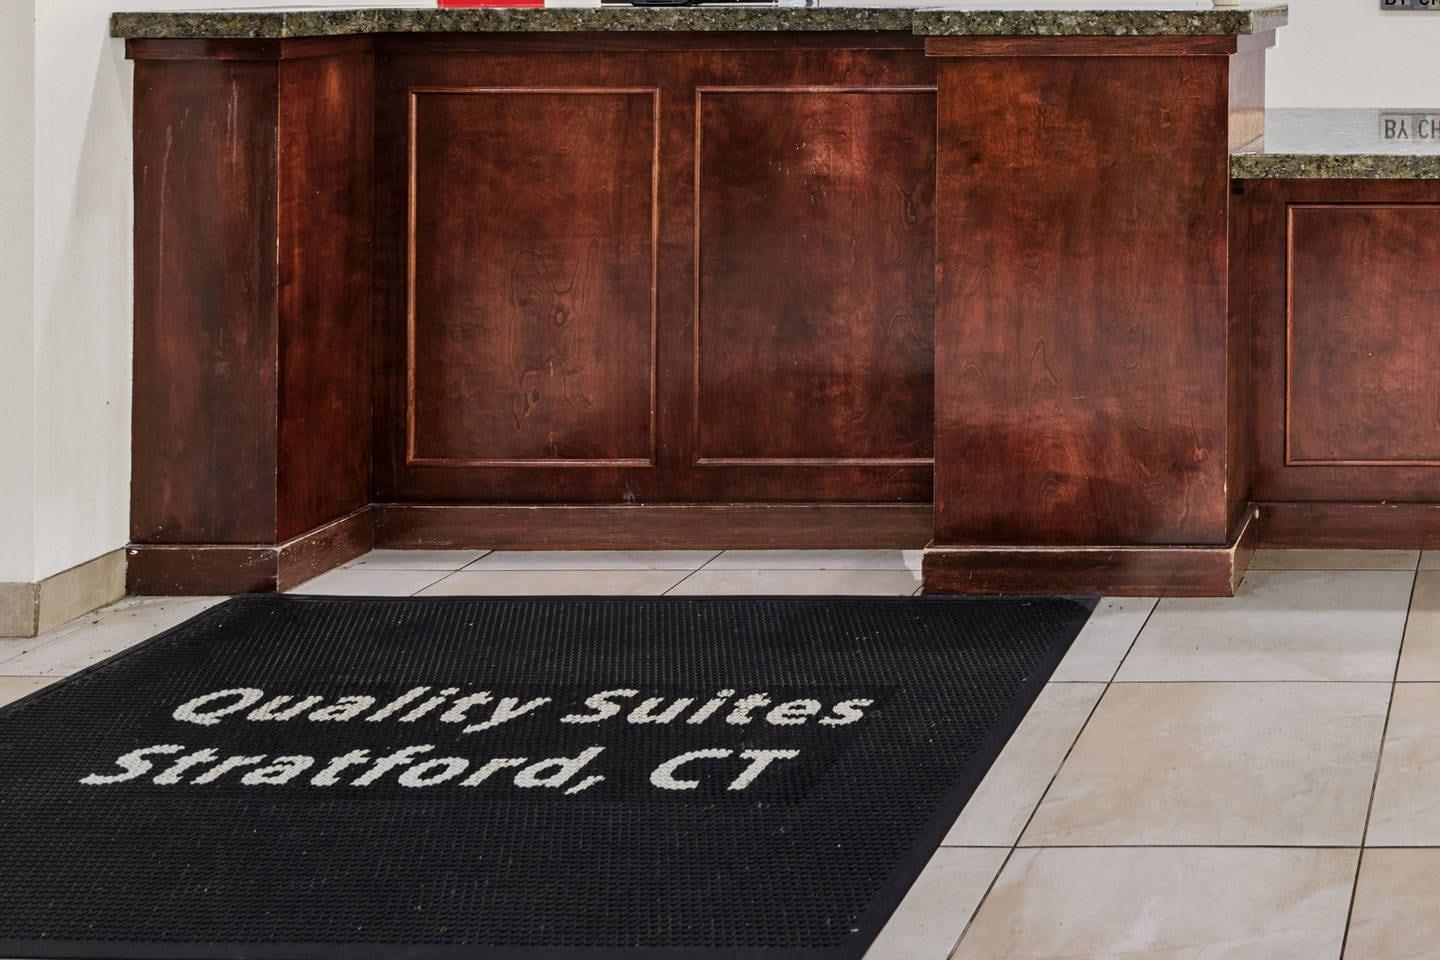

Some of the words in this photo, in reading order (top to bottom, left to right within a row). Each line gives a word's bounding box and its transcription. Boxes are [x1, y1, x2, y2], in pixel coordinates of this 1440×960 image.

[172, 686, 551, 734] Quality
[560, 688, 874, 729] Suites
[78, 743, 605, 796] Stratford,
[649, 748, 802, 791] CT
